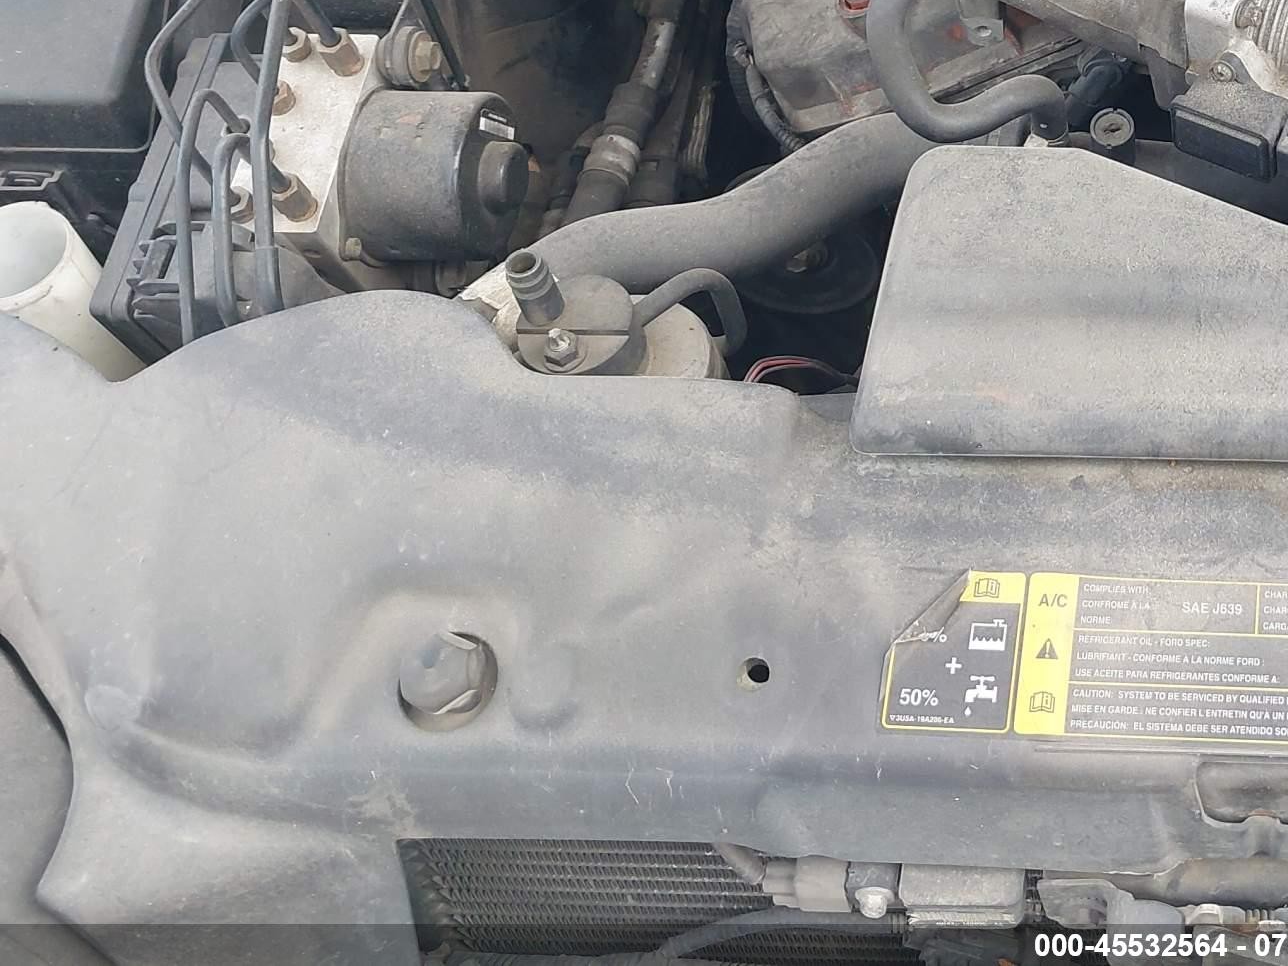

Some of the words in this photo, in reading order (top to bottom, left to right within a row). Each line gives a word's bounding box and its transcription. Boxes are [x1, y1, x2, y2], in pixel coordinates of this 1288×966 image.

[1038, 594, 1068, 607] A/C
[1182, 601, 1208, 614] SAE
[1213, 603, 1242, 615] J639
[1079, 635, 1137, 646] REFRIGERANT
[1160, 638, 1183, 647] FORD
[1077, 652, 1125, 661] LUBRIFIANT
[1133, 653, 1180, 663] CONFORME
[1192, 656, 1202, 664] LA
[1204, 656, 1234, 665] NORME
[1237, 657, 1260, 666] FORD
[1075, 669, 1091, 677] USE
[1126, 670, 1148, 679] PARA
[1151, 671, 1219, 681] REFRIGERANTES
[1222, 673, 1269, 683] CONFORME
[899, 688, 938, 706] 50%
[1073, 689, 1114, 698] CAUTION:
[1118, 691, 1152, 700] SYSTEM
[1155, 692, 1165, 700] TO
[1168, 692, 1179, 700] BE
[1181, 693, 1224, 702] SERVICED
[1226, 694, 1238, 702] BY
[1240, 694, 1284, 704] QUALIFIED
[1072, 705, 1092, 713] MISE
[1094, 706, 1106, 714] EN
[1145, 707, 1157, 715] NE
[1159, 708, 1197, 716] CONFIER
[1273, 712, 1284, 720] UN
[1134, 723, 1144, 731] EL
[1146, 724, 1183, 732] SISTEMA
[1185, 725, 1208, 733] DEBE
[1211, 725, 1228, 733] SER
[1230, 726, 1272, 736] ATENDIDO
